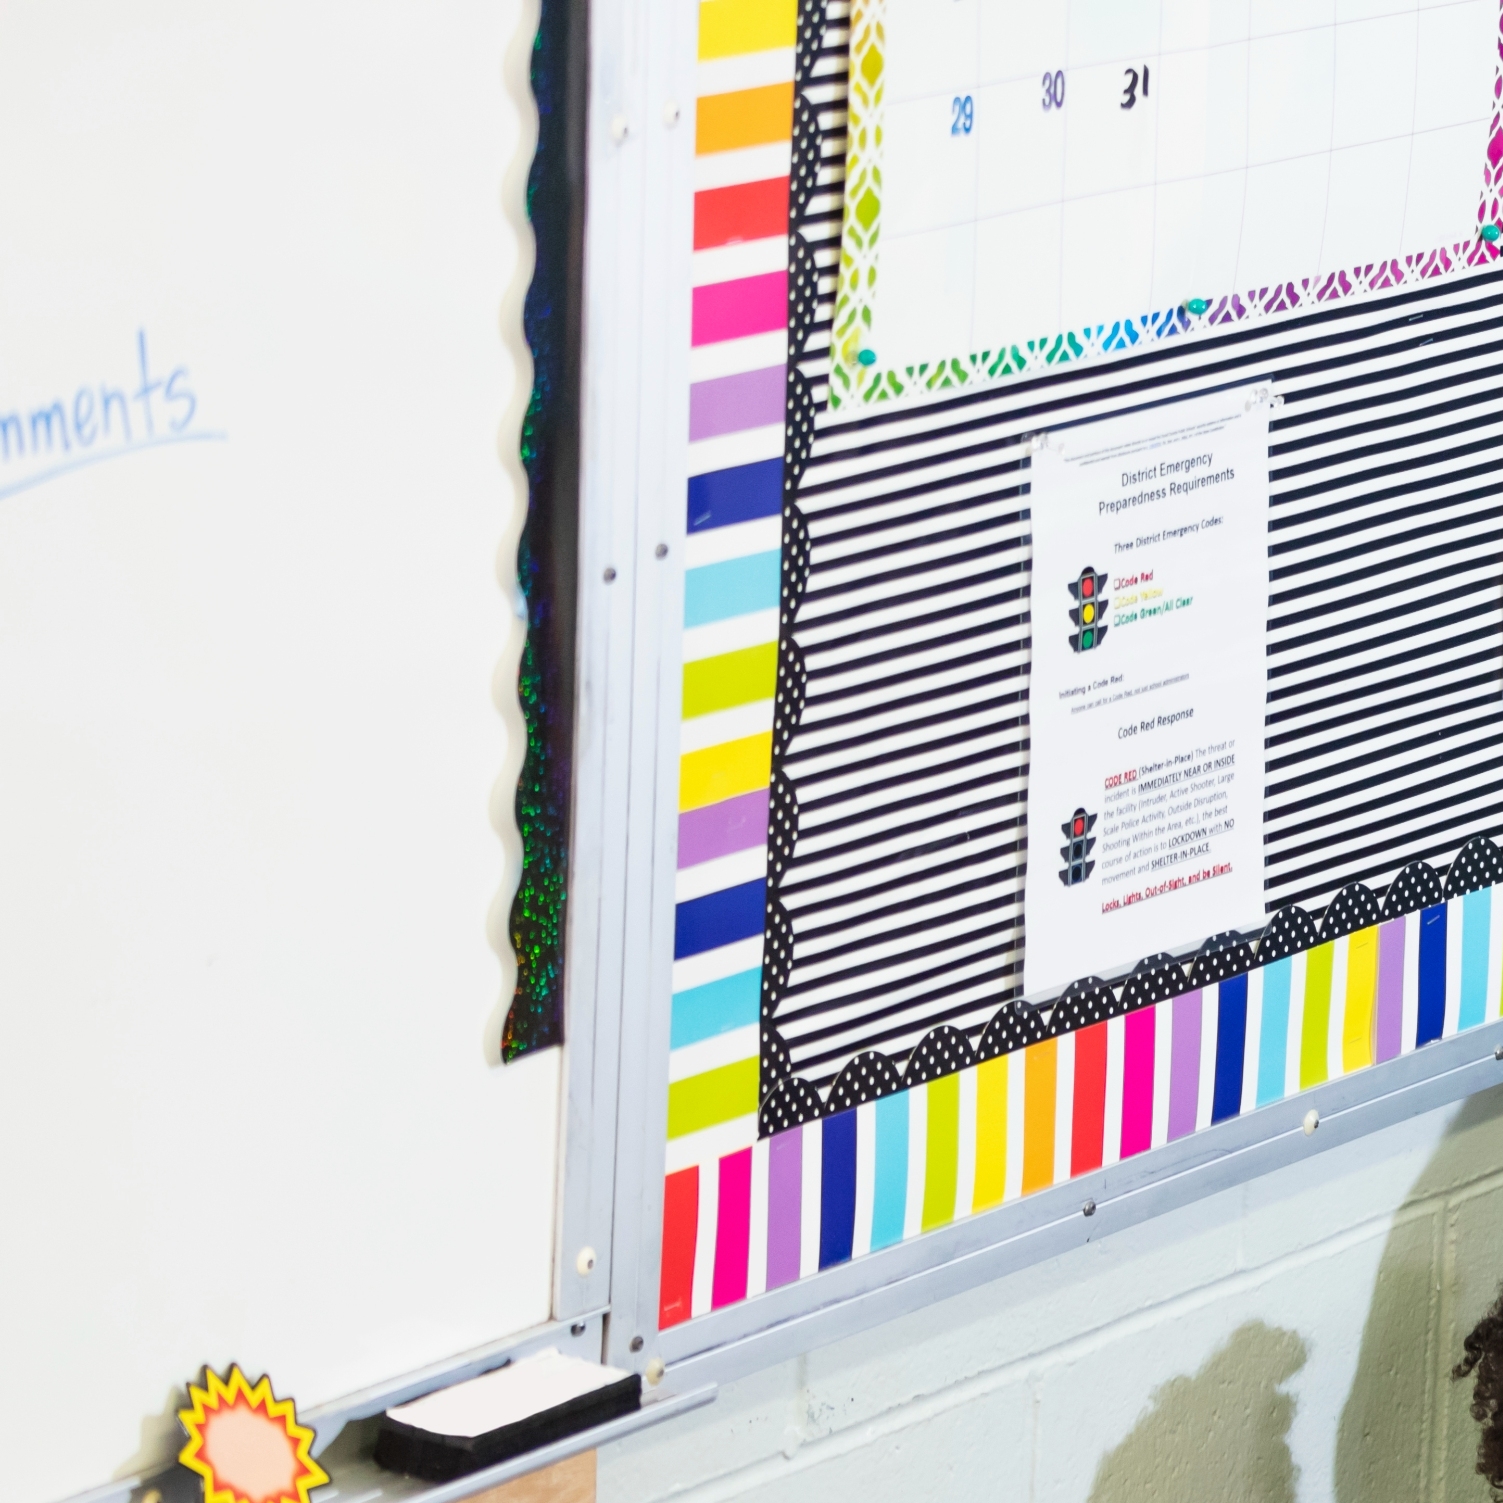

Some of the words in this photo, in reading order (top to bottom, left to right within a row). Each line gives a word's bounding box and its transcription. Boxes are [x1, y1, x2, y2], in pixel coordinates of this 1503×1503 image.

[1042, 70, 1065, 111] 30
[1120, 65, 1149, 109] 31
[950, 96, 974, 137] 29
[1122, 466, 1156, 487] District
[1160, 454, 1212, 476] Emergency
[1099, 488, 1166, 515] Preparedness
[1170, 468, 1234, 496] Requirements
[1114, 542, 1133, 553] Three
[1136, 533, 1160, 548] District
[1163, 524, 1199, 540] Emergency
[1201, 516, 1223, 529] Codes:
[1120, 576, 1138, 588] Code
[1141, 570, 1153, 582] Red
[1120, 612, 1138, 625] Code
[1176, 597, 1192, 609] Clear
[1118, 724, 1138, 739] Code
[1140, 718, 1155, 732] Red
[1157, 708, 1194, 726] Response
[1105, 774, 1122, 790] CODE
[1123, 770, 1137, 784] RED
[1195, 748, 1206, 758] The
[1208, 741, 1226, 754] threat
[1228, 740, 1235, 748] or
[1105, 788, 1129, 803] incident
[1132, 787, 1136, 795] is
[1138, 772, 1182, 792] IMMEDIATELY
[1184, 765, 1201, 778] NEAR
[1203, 762, 1212, 772] OR
[1214, 754, 1234, 768] INSIDE
[1104, 810, 1114, 820] the
[1116, 804, 1137, 816] facility
[1170, 788, 1188, 798] Active
[1218, 773, 1234, 784] Large
[1104, 824, 1119, 837] Scale
[1121, 818, 1139, 830] Police
[1168, 801, 1192, 816] Outside
[1102, 856, 1123, 869] course
[1125, 850, 1131, 862] of
[1133, 847, 1152, 859] action
[1154, 844, 1158, 852] is
[1160, 842, 1167, 850] to
[1169, 828, 1206, 848] LOCKDOWN
[1209, 822, 1222, 835] with
[1224, 818, 1234, 829] NO
[1102, 866, 1136, 885] movement
[1138, 861, 1149, 874] and
